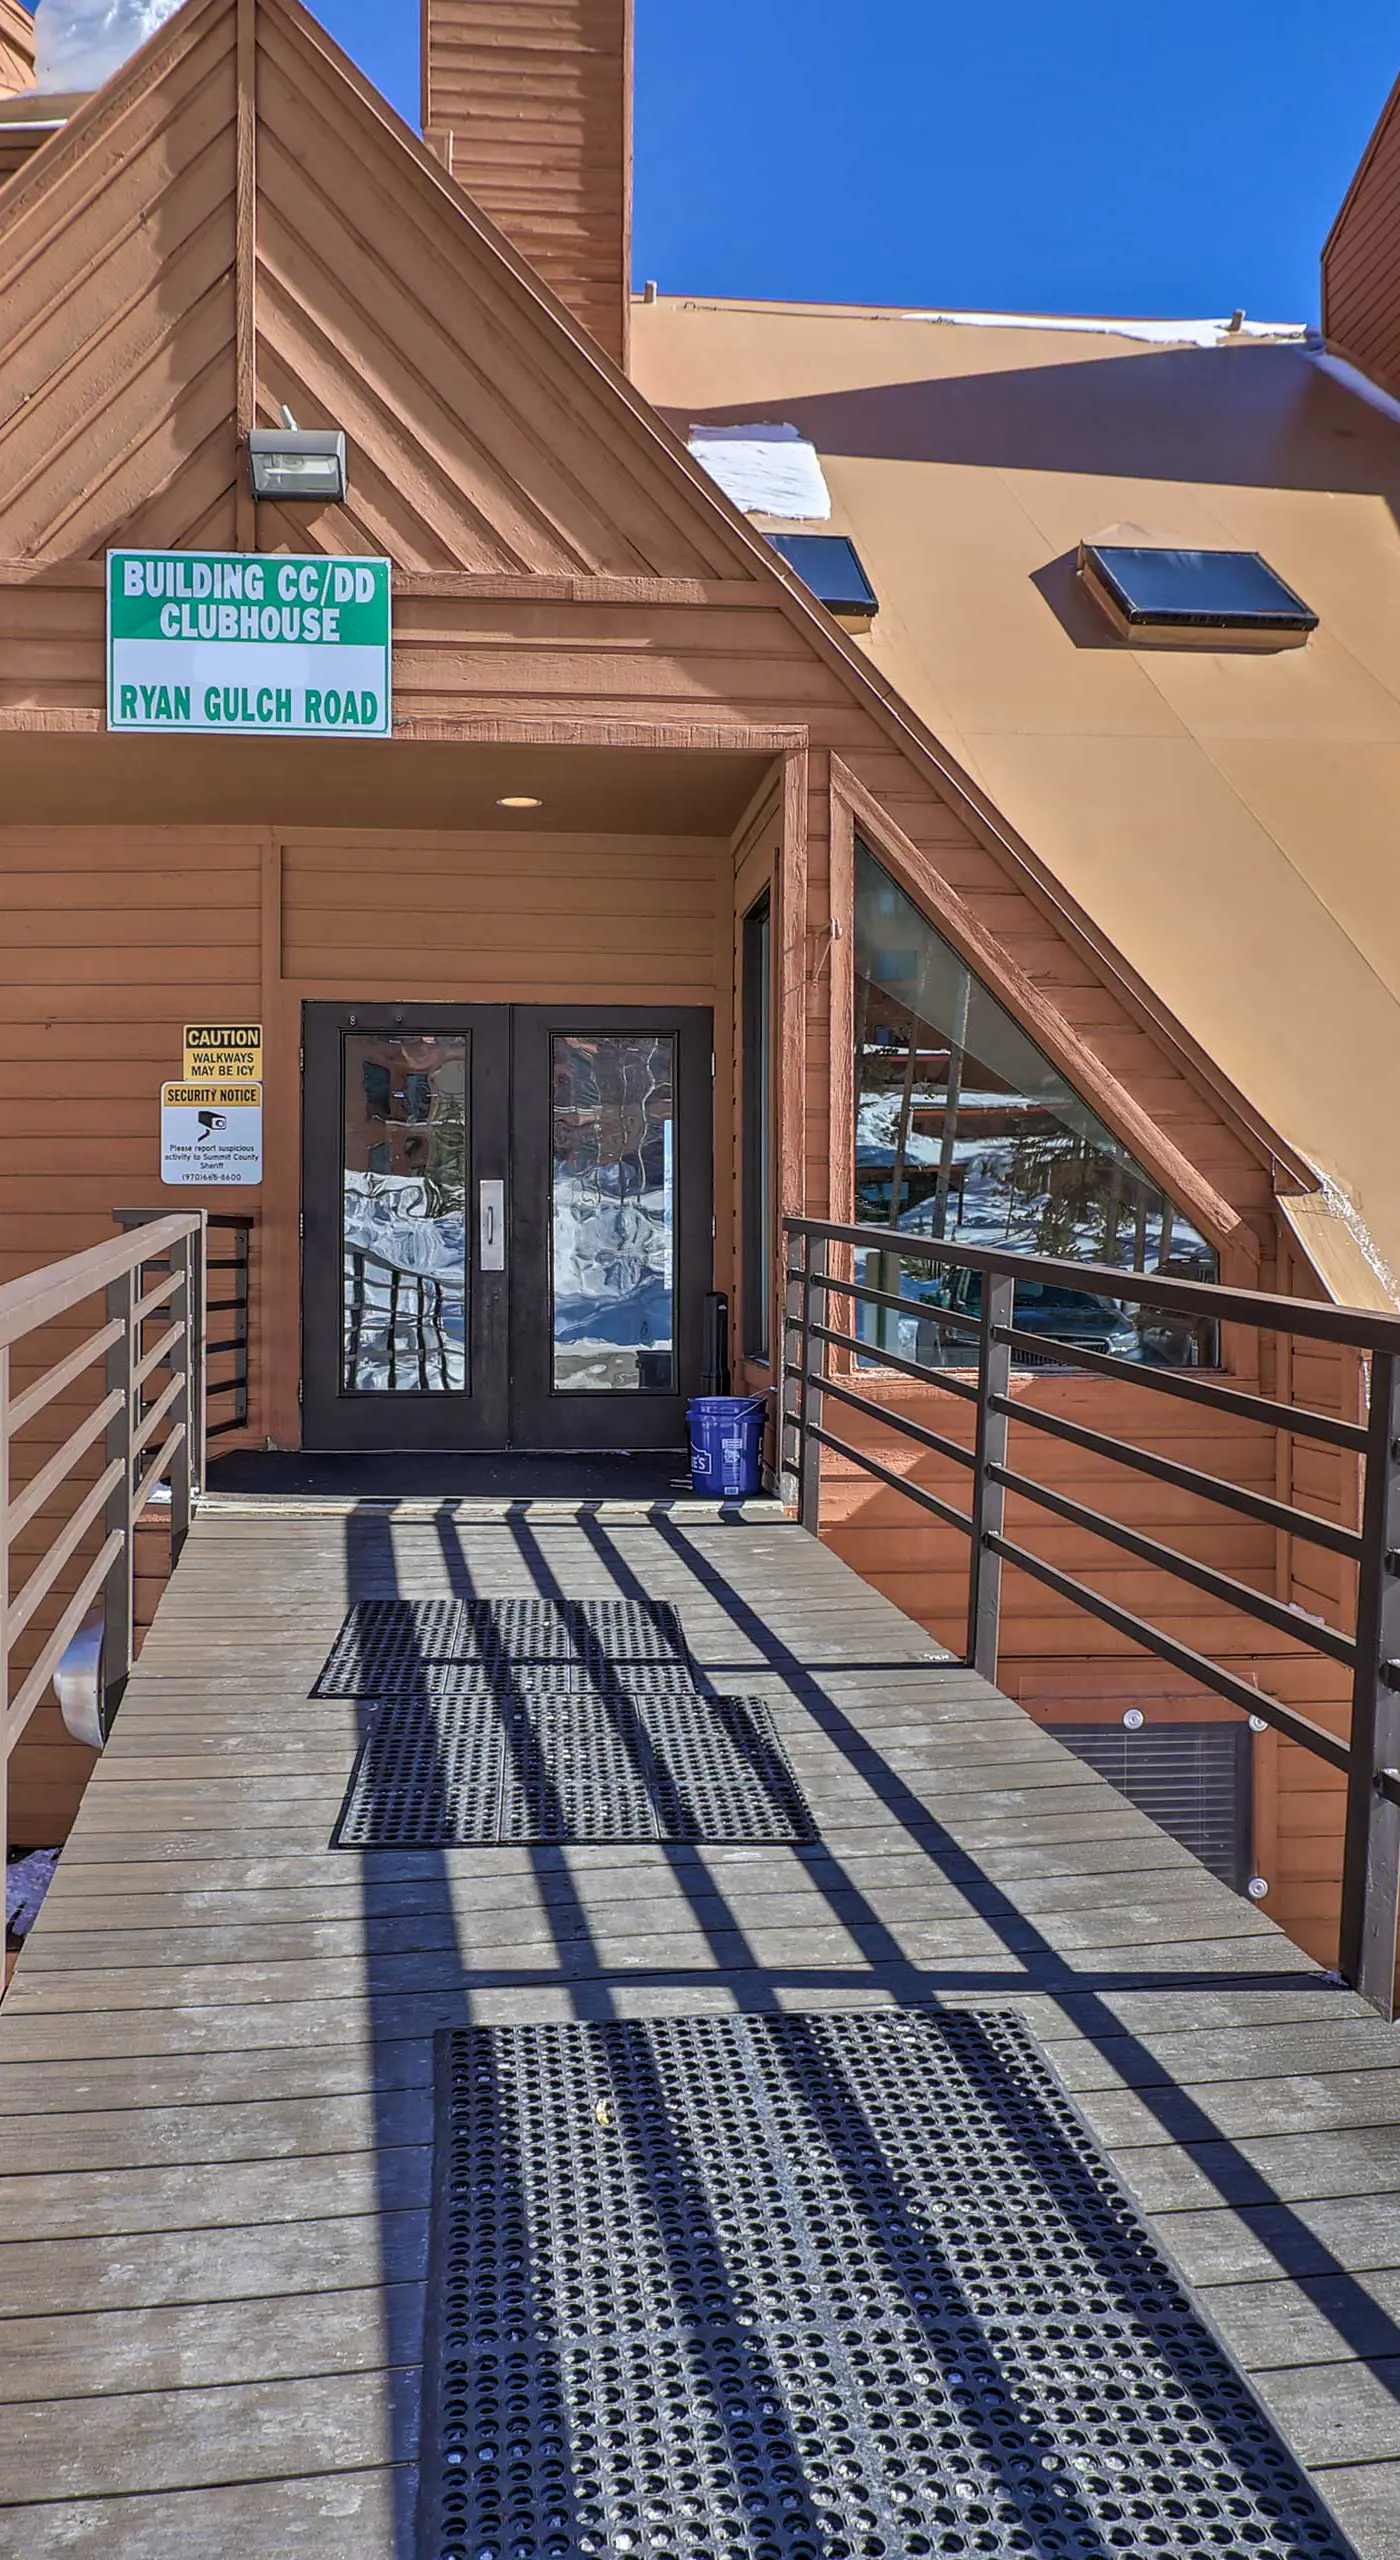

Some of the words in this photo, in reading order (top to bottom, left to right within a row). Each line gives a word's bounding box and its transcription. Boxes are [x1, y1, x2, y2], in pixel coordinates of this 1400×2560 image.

[123, 560, 264, 600] BUILDING
[277, 562, 376, 606] CC/DD
[160, 603, 340, 641] CLUBHOUSE
[120, 685, 191, 720] RYAN
[204, 686, 292, 722] GULCH
[305, 689, 378, 725] ROAD
[188, 1030, 259, 1046] CAUTION
[192, 1052, 254, 1063] WALKWAYS
[191, 1065, 215, 1076] MAY
[218, 1065, 233, 1076] BE
[236, 1065, 255, 1076] ICY
[167, 1088, 217, 1102] SECURITY
[220, 1088, 257, 1102] NOTICE
[169, 1144, 192, 1152] Please
[194, 1144, 216, 1154] report
[218, 1144, 254, 1153] suspicious
[164, 1153, 191, 1162] activity
[193, 1153, 201, 1161] to
[203, 1153, 231, 1161] Summit
[233, 1153, 259, 1162] County
